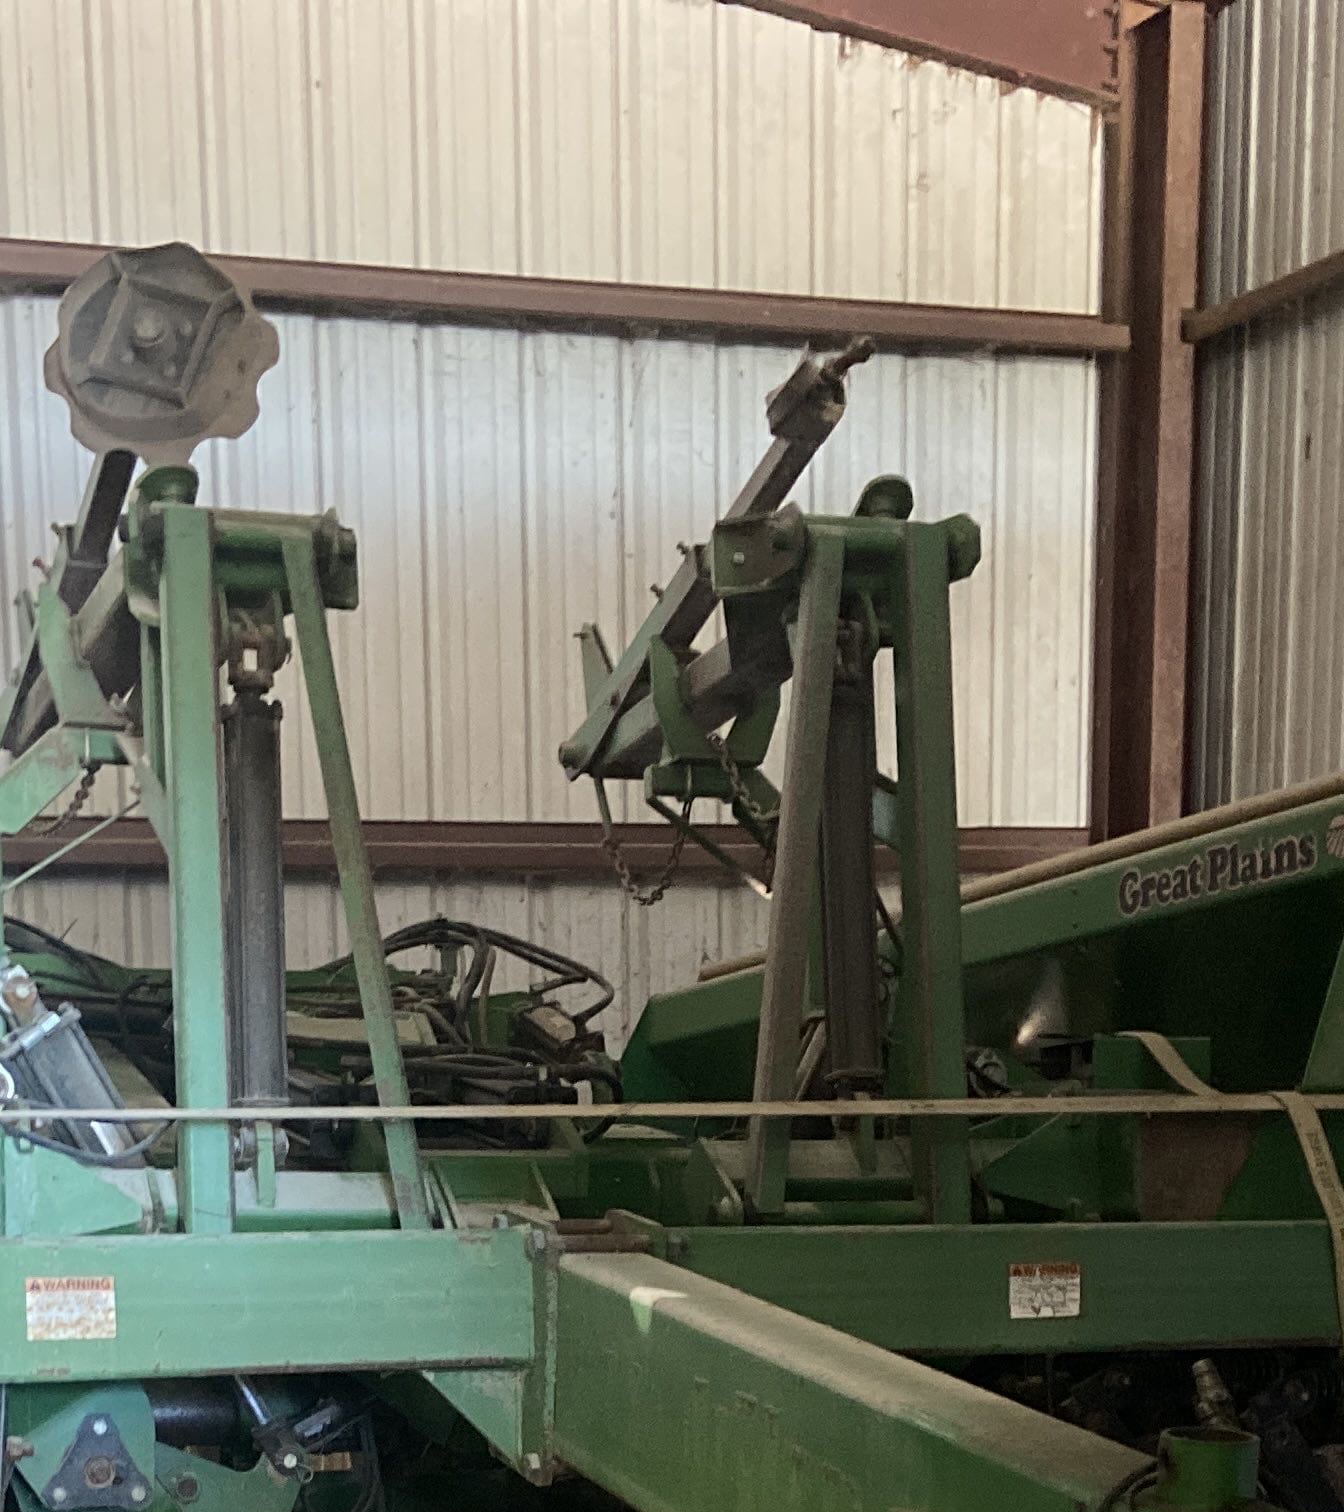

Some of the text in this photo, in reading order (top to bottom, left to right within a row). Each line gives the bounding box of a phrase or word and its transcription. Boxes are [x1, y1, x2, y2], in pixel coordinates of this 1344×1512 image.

[1119, 834, 1317, 915] Great Plains
[43, 1278, 111, 1291] WARNING
